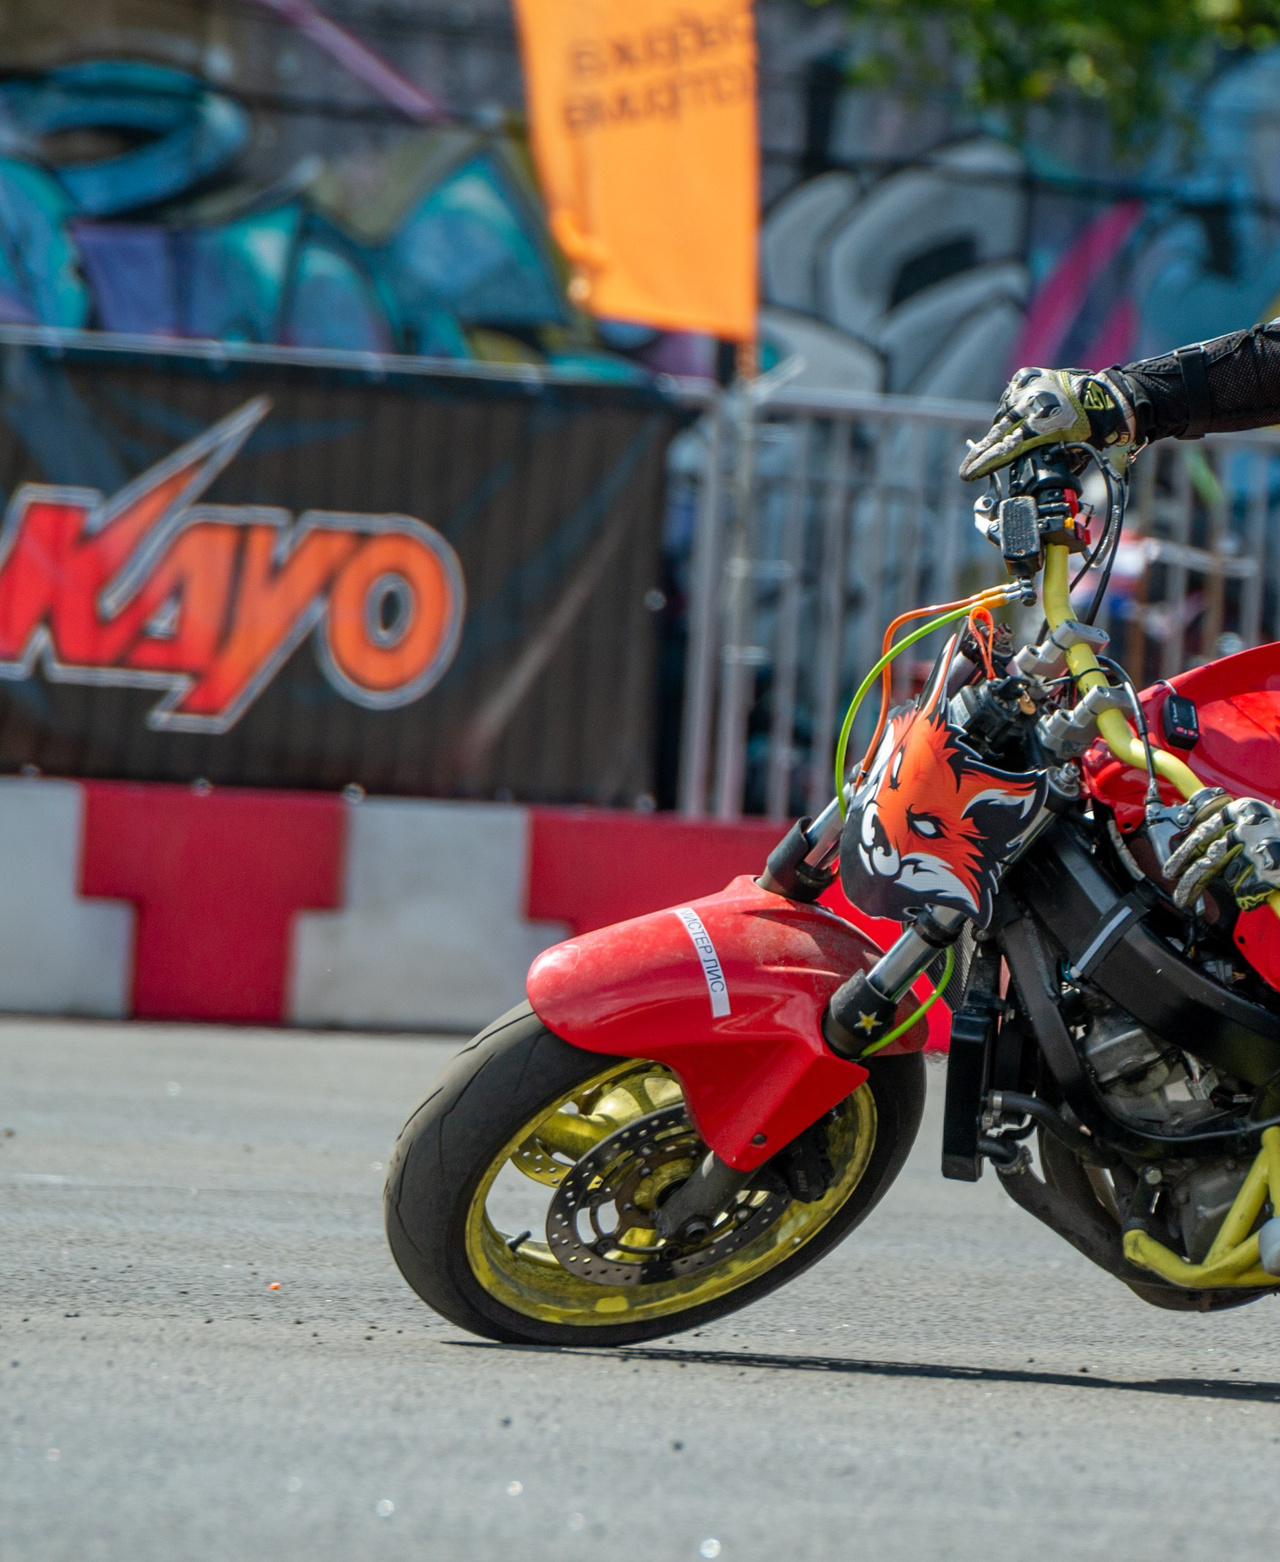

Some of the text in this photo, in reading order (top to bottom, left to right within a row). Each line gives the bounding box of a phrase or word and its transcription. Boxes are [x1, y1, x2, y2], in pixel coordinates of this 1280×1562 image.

[0, 395, 466, 734] KAYO
[680, 909, 725, 993] МИСТЕР ЛИС
